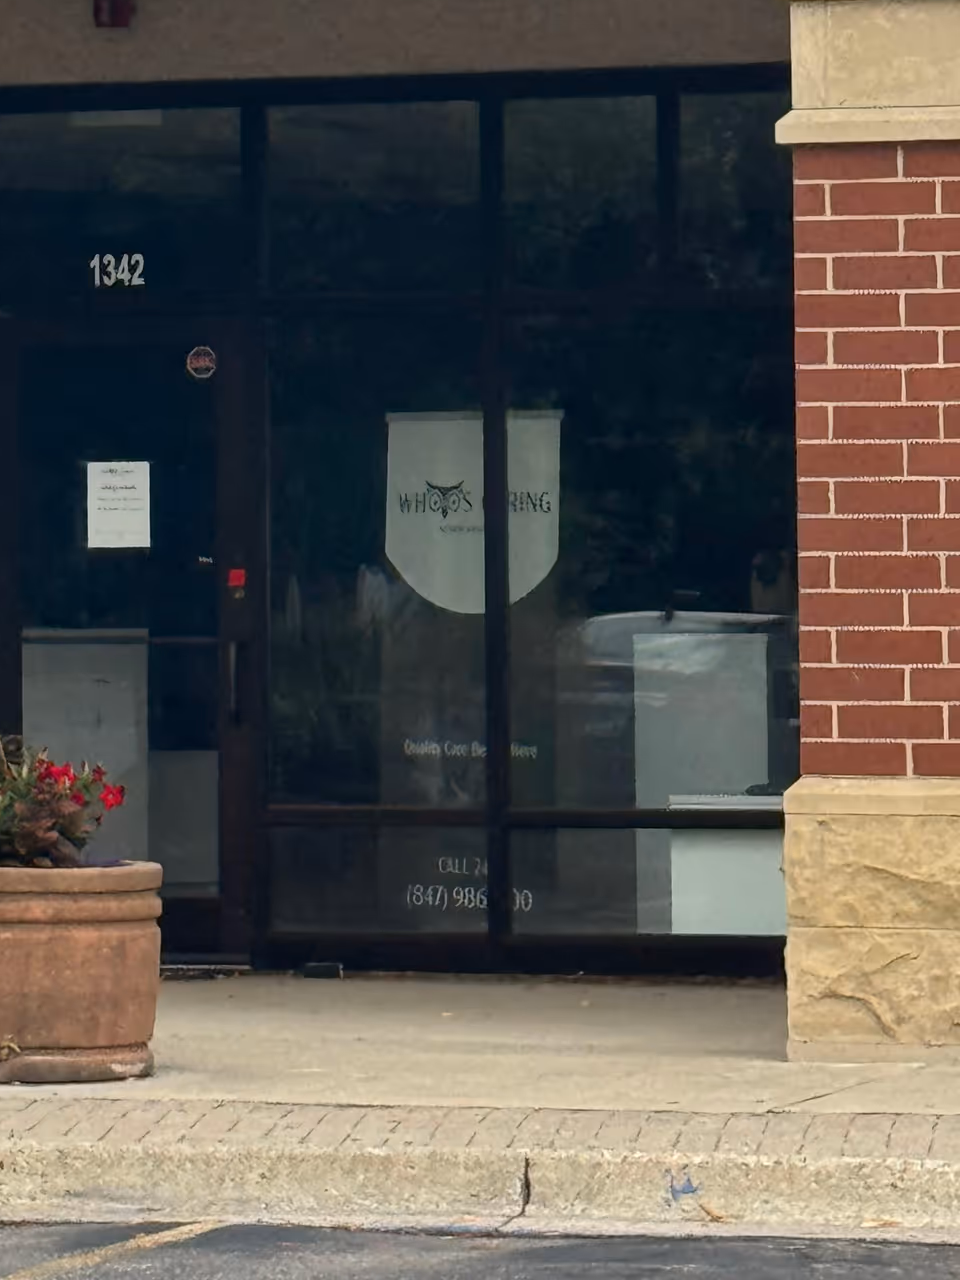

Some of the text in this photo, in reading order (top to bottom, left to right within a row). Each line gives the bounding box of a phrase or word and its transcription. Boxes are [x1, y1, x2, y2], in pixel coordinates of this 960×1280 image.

[89, 253, 145, 288] 1342
[438, 856, 469, 875] CALL
[406, 884, 448, 912] (847)
